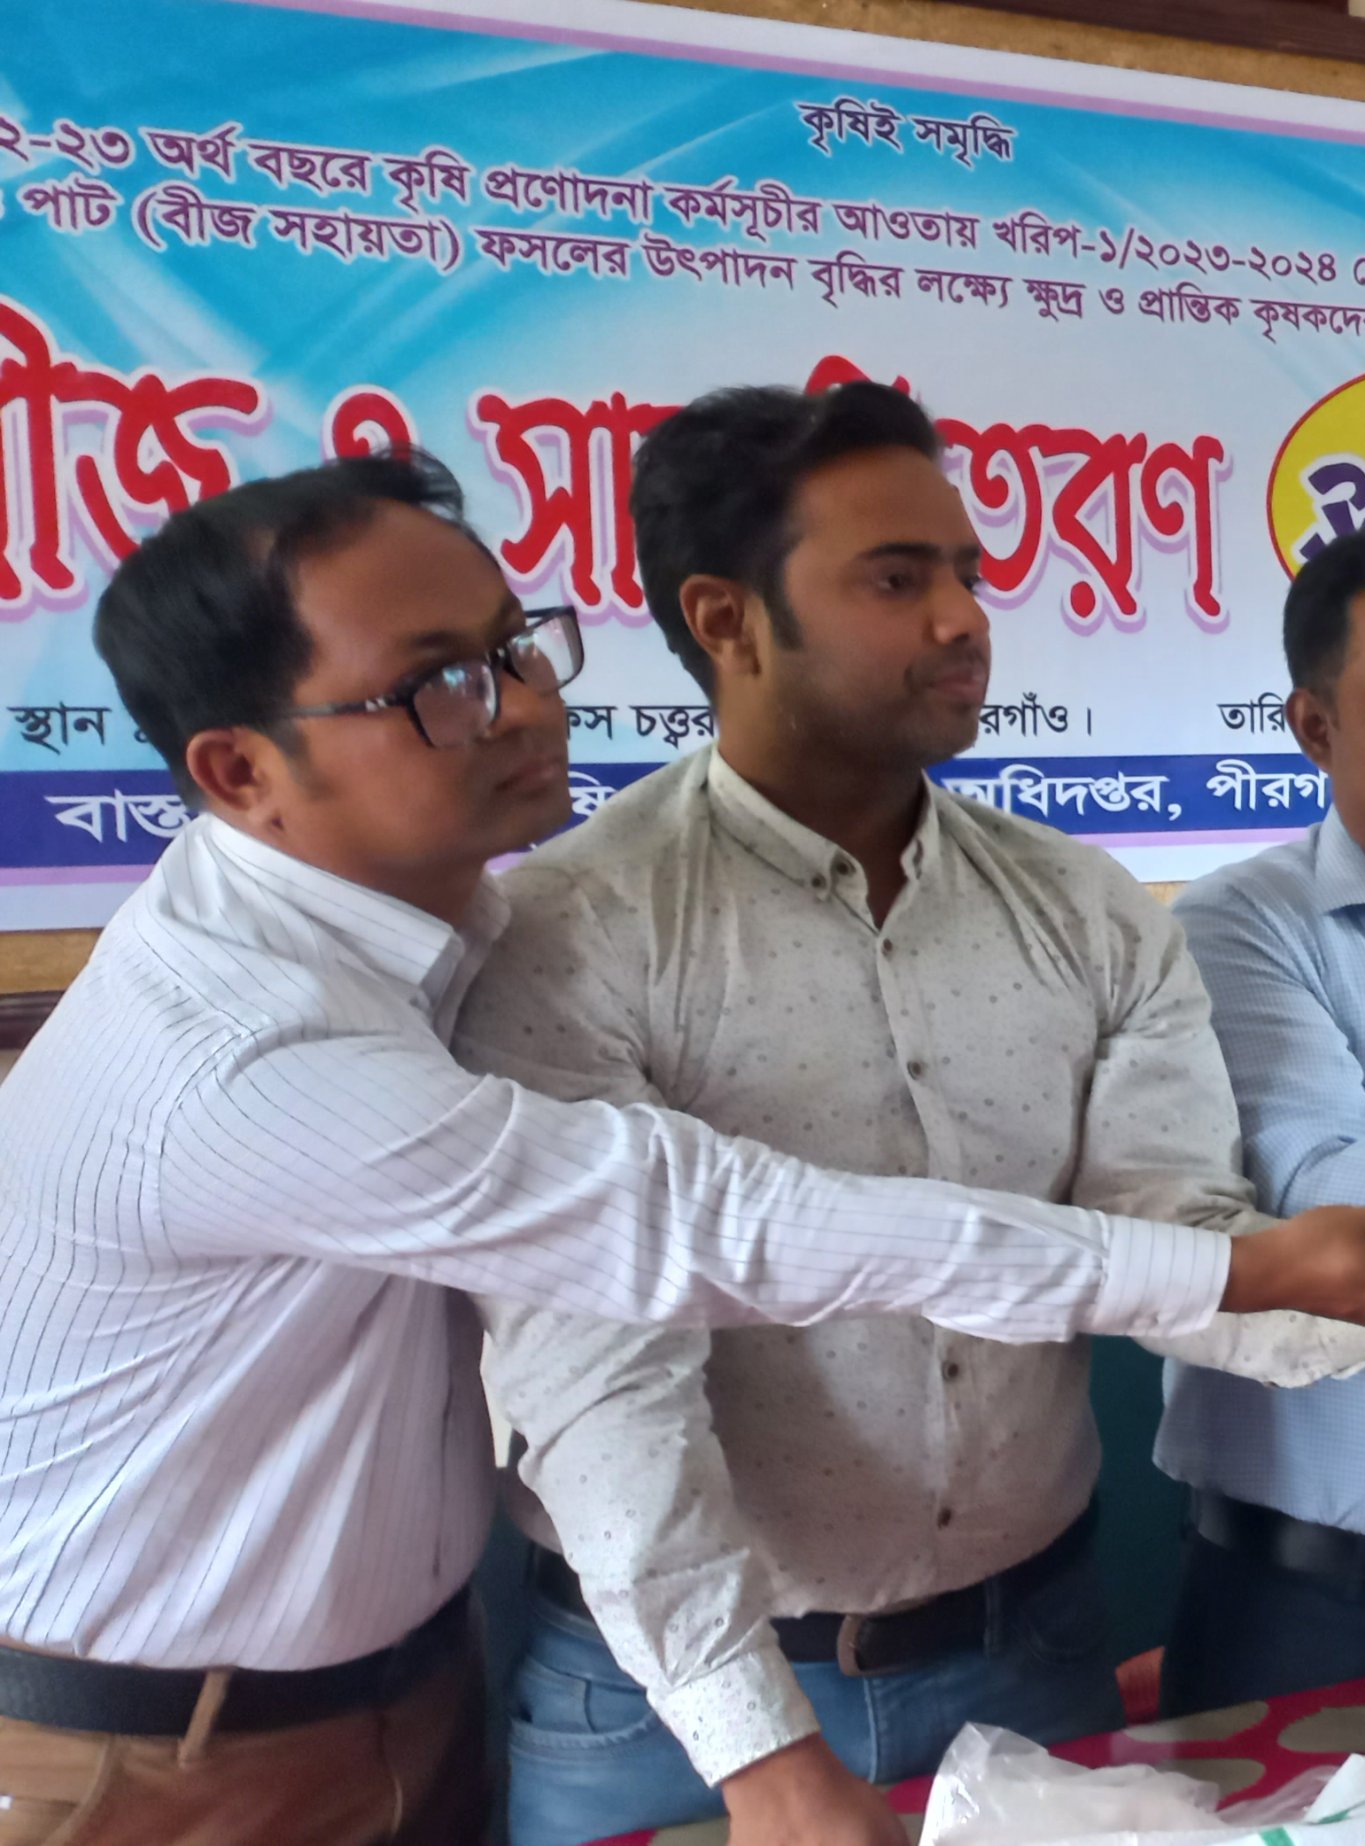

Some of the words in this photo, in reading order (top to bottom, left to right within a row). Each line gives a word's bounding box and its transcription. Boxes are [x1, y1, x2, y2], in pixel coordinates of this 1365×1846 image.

[799, 100, 902, 152] কৃষিই
[912, 115, 1013, 166] সমৃদ্ধি
[146, 126, 237, 177] অর্থ
[248, 144, 371, 192] বছরে
[384, 150, 469, 212] কৃষি
[486, 167, 652, 220] প্রণোদনা
[664, 177, 821, 242] কর্মসূচীর
[833, 204, 980, 248] আওতায়
[992, 211, 1336, 285] খরিপ-১/২০২৩-২০২৪
[23, 177, 117, 230] পাট
[137, 185, 257, 247] (বীজ
[268, 208, 460, 271] সহায়তা)
[474, 228, 631, 276] ফসলের
[642, 234, 796, 289] উৎপাদন
[809, 250, 903, 307] বৃদ্ধির
[915, 268, 1012, 307] লক্ষ্যে
[1024, 278, 1086, 322] ক্ষুদ্র
[1099, 287, 1124, 315] ও
[1138, 282, 1242, 325] প্রান্তিক
[0, 320, 258, 600] ীজ
[477, 391, 686, 609] সা
[6, 701, 112, 755] স্থান
[979, 692, 1069, 735] রগাঁও
[1217, 692, 1286, 734] তারি
[44, 788, 191, 843] বাস্ত
[941, 763, 1182, 821] অধিদপ্তর,
[1207, 760, 1329, 811] পীরগ
